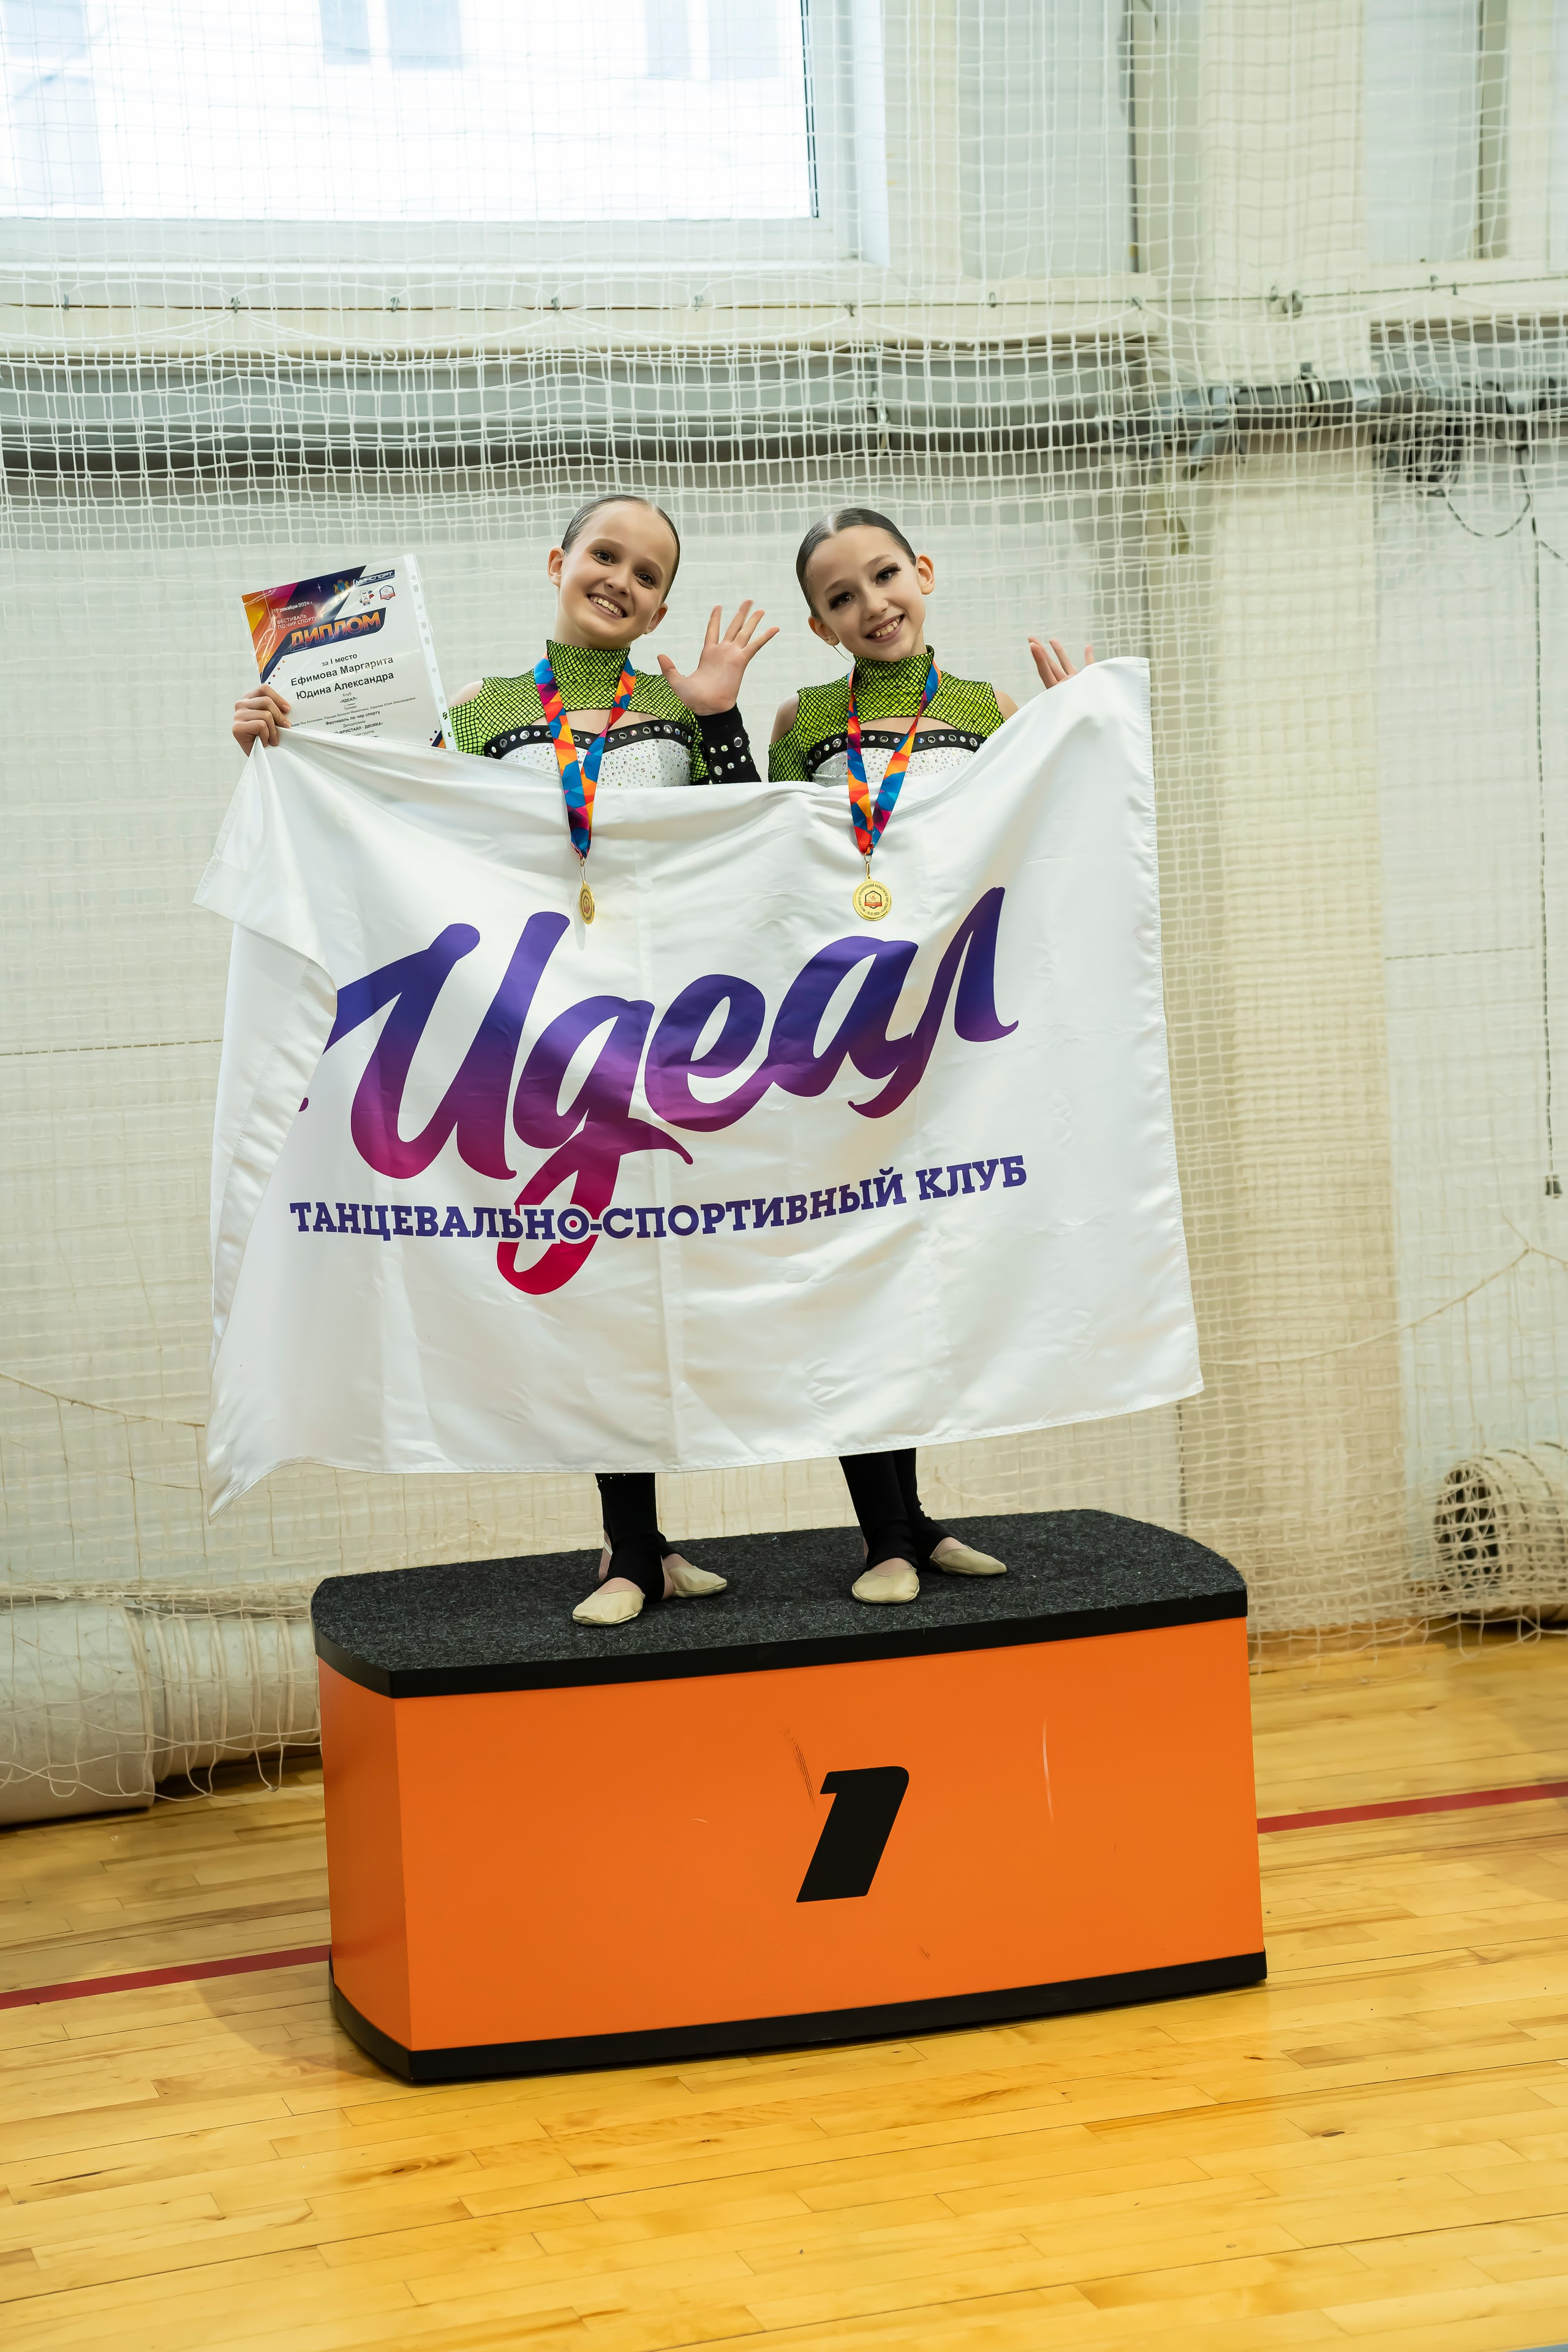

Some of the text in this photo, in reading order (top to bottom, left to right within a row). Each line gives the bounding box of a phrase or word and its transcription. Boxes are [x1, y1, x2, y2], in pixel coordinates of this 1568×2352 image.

[355, 571, 393, 585] МИНСПОРТ
[276, 614, 307, 625] ФЕСТИВАЛЬ
[290, 611, 381, 652] ДИПЛОМ
[297, 616, 317, 625] СПОРТУ
[290, 657, 394, 687] Ефимова Маргарита
[334, 654, 358, 663] место
[296, 673, 394, 700] Юдина Александра
[289, 1155, 1027, 1242] ТАНЦЕВАЛЬНО-СПОРТИВНЫЙ КЛУБ
[796, 1765, 909, 1903] 1
